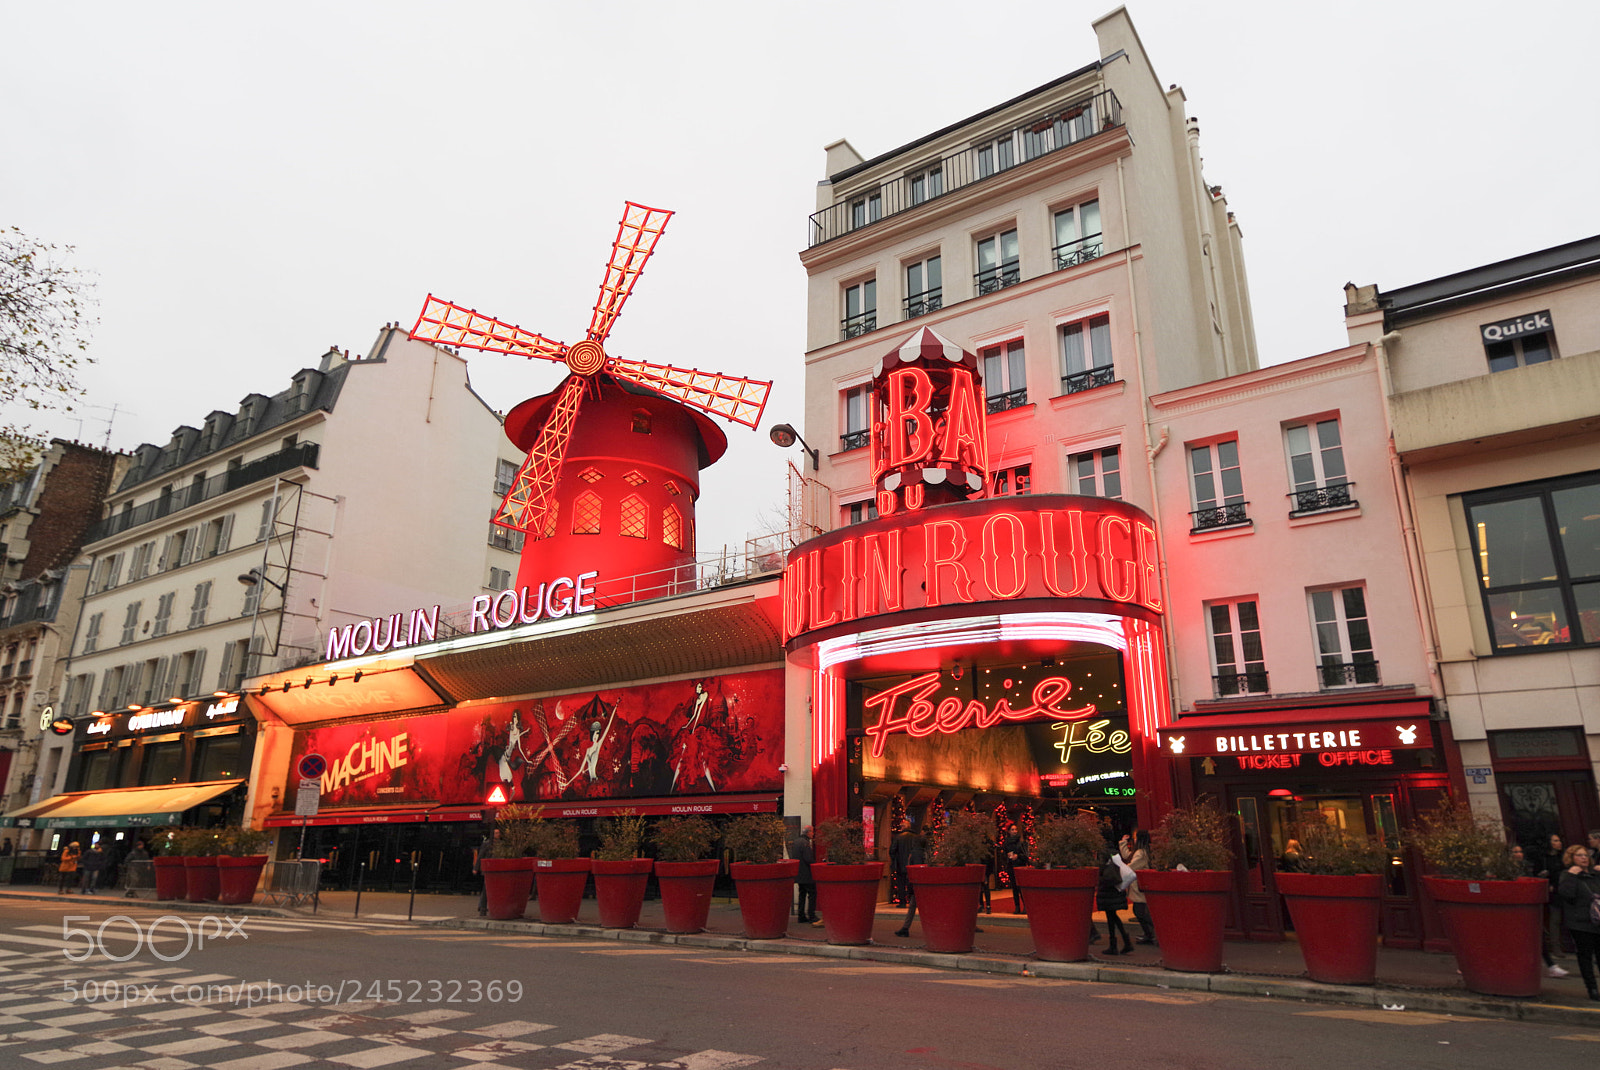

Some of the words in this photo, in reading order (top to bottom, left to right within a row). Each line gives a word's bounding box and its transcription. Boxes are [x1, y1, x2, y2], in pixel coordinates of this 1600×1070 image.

[1483, 314, 1550, 341] Quick
[888, 367, 988, 476] BA
[877, 484, 923, 516] DU
[783, 529, 903, 641] ULIN
[924, 510, 1163, 614] ROUGE
[326, 605, 440, 660] MOULIN
[470, 570, 598, 632] ROUGE
[865, 671, 1097, 759] Féerie
[1051, 719, 1132, 764] Fée
[1216, 730, 1361, 752] BILLETTERIE
[320, 732, 407, 795] MACHINE
[1237, 753, 1302, 769] TICKET
[1318, 750, 1394, 767] OFFICE
